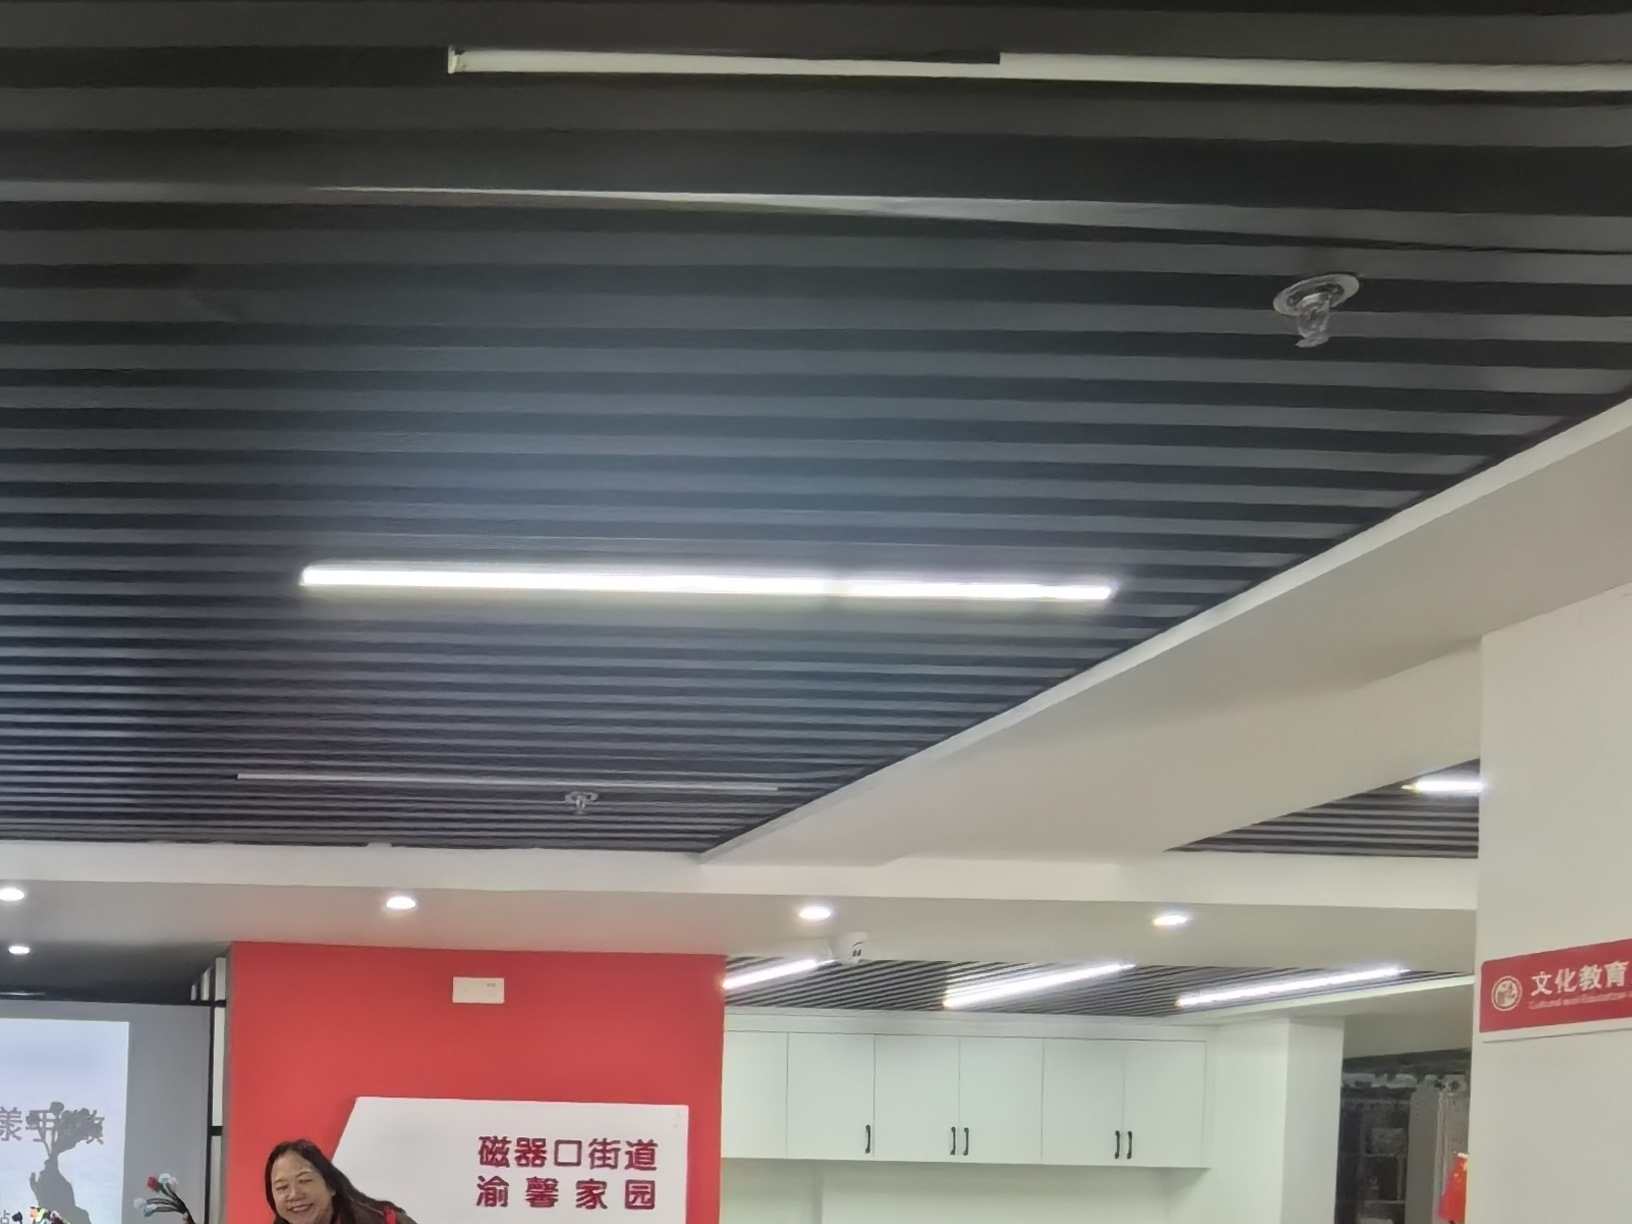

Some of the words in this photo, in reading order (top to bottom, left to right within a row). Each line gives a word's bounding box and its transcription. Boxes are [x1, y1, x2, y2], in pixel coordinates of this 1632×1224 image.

[1530, 960, 1630, 997] 文化教育
[478, 1135, 659, 1172] 磁器口街道
[476, 1175, 656, 1210] 渝馨家园
